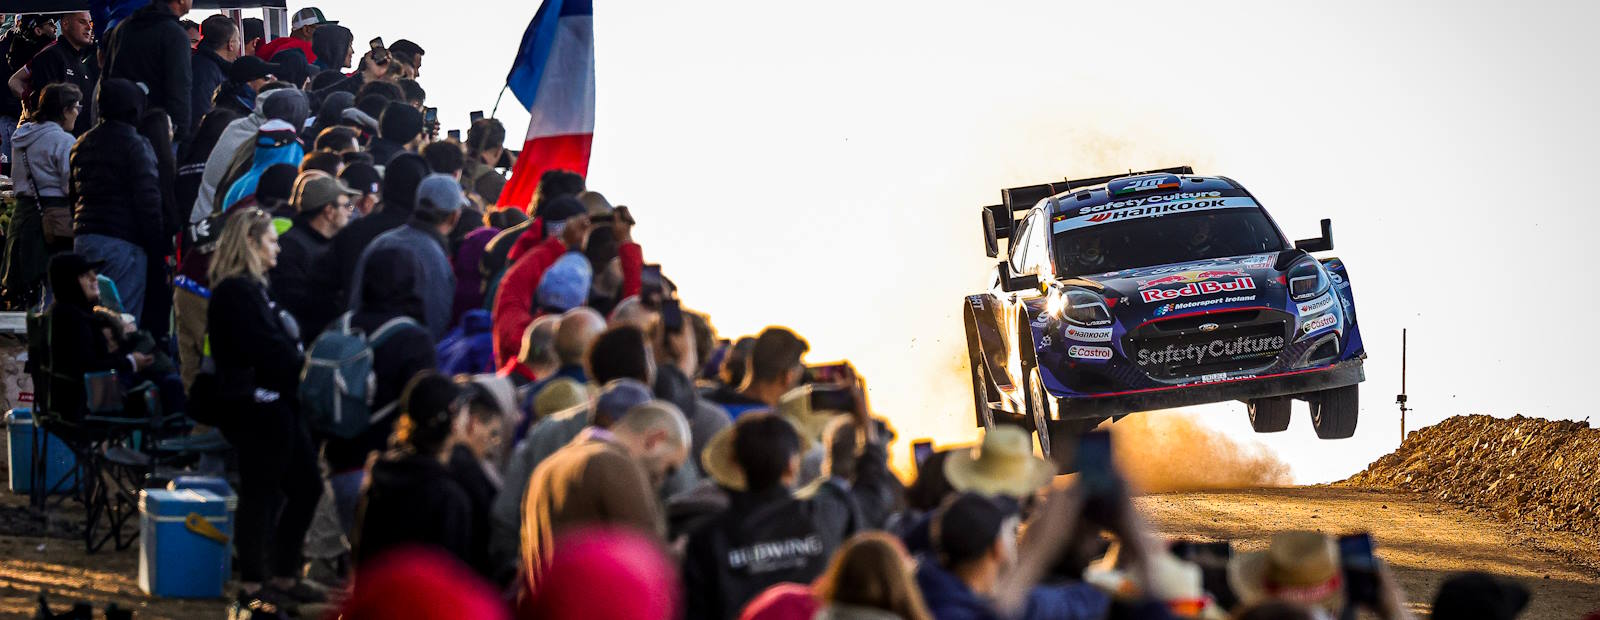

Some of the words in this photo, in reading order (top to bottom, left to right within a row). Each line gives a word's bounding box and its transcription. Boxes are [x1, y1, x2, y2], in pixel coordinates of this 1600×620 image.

[1079, 190, 1221, 215] SafetyCulture
[1139, 282, 1200, 303] Red
[1200, 276, 1256, 295] Bull
[1174, 299, 1223, 310] Motorsport
[1224, 294, 1256, 304] Ireland
[1310, 314, 1336, 330] Castrol
[1077, 348, 1110, 358] Castrol
[1137, 335, 1284, 366] SafetyCulture
